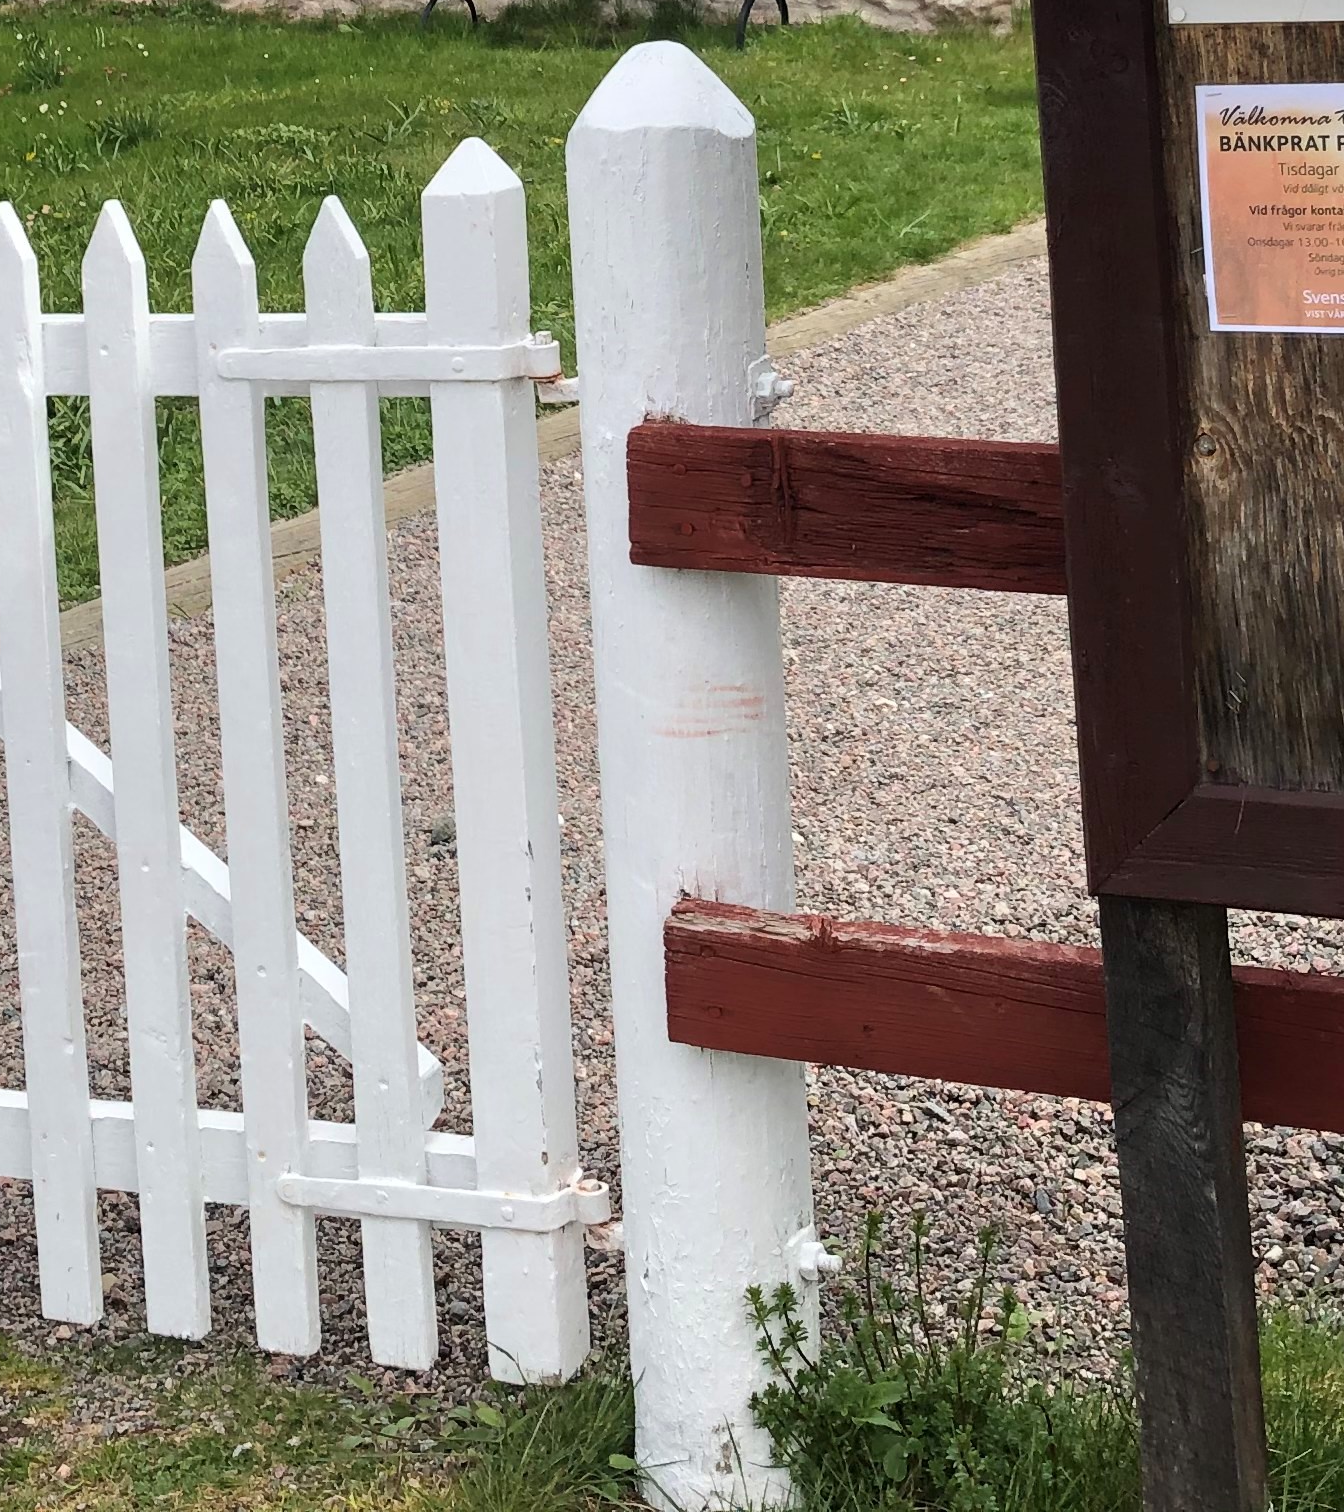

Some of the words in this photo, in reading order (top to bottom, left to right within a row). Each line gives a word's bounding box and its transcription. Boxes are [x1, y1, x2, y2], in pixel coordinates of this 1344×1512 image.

[1220, 106, 1331, 126] Välkomna
[1220, 132, 1330, 152] BÄNKPRAT
[1278, 163, 1338, 178] Tisdagar
[1284, 184, 1299, 194] Vid
[1302, 184, 1328, 195] dåligt
[1249, 206, 1267, 216] Vid
[1270, 205, 1307, 218] frågor
[1283, 222, 1293, 231] Vi
[1248, 237, 1296, 247] Onsdagar
